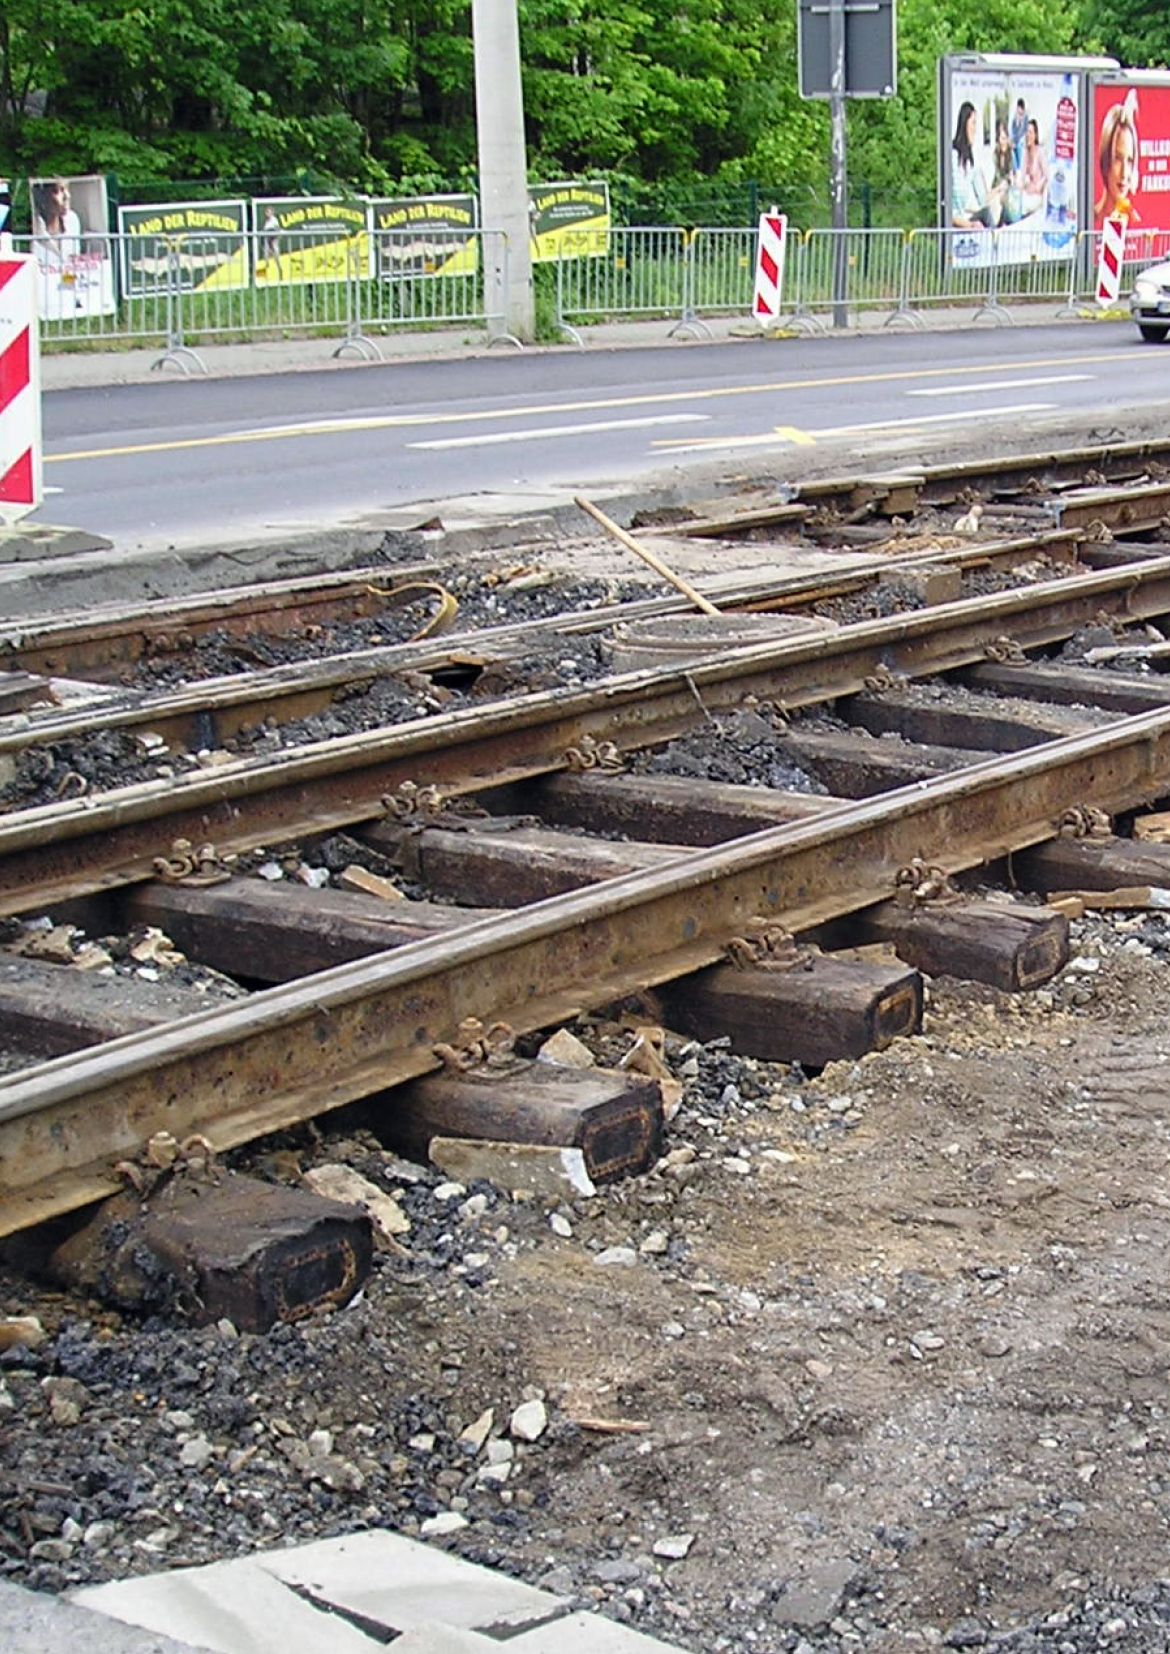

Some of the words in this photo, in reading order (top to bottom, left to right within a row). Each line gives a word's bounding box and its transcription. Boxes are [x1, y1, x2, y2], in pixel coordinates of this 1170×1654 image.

[536, 193, 556, 210] LAND
[556, 191, 570, 203] DER
[571, 189, 604, 206] REPTILIEN
[129, 219, 163, 240] LAND
[164, 213, 185, 229] DER
[185, 210, 239, 232] REPTILIEN
[280, 209, 306, 228] LAND
[307, 207, 323, 220] DER
[323, 205, 365, 225] REPTILIEN
[379, 210, 408, 229] LAND
[408, 205, 425, 219] DER
[425, 204, 471, 224] REPTILIEN
